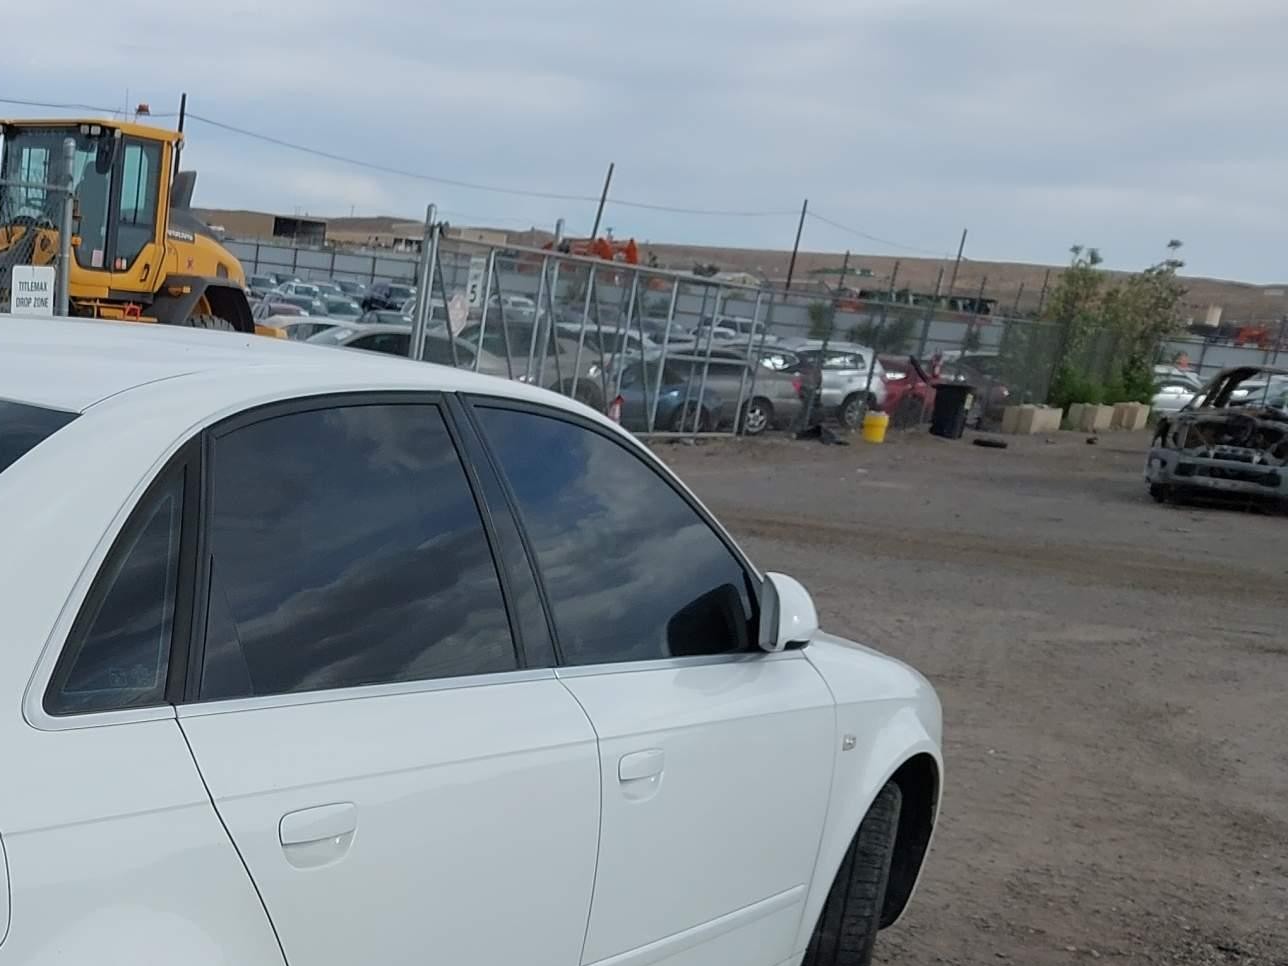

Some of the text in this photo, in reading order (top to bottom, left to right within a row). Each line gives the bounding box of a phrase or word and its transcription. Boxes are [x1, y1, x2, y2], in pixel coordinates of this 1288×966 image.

[17, 281, 48, 292] TITLEMAX
[15, 297, 49, 308] DROP ZONE
